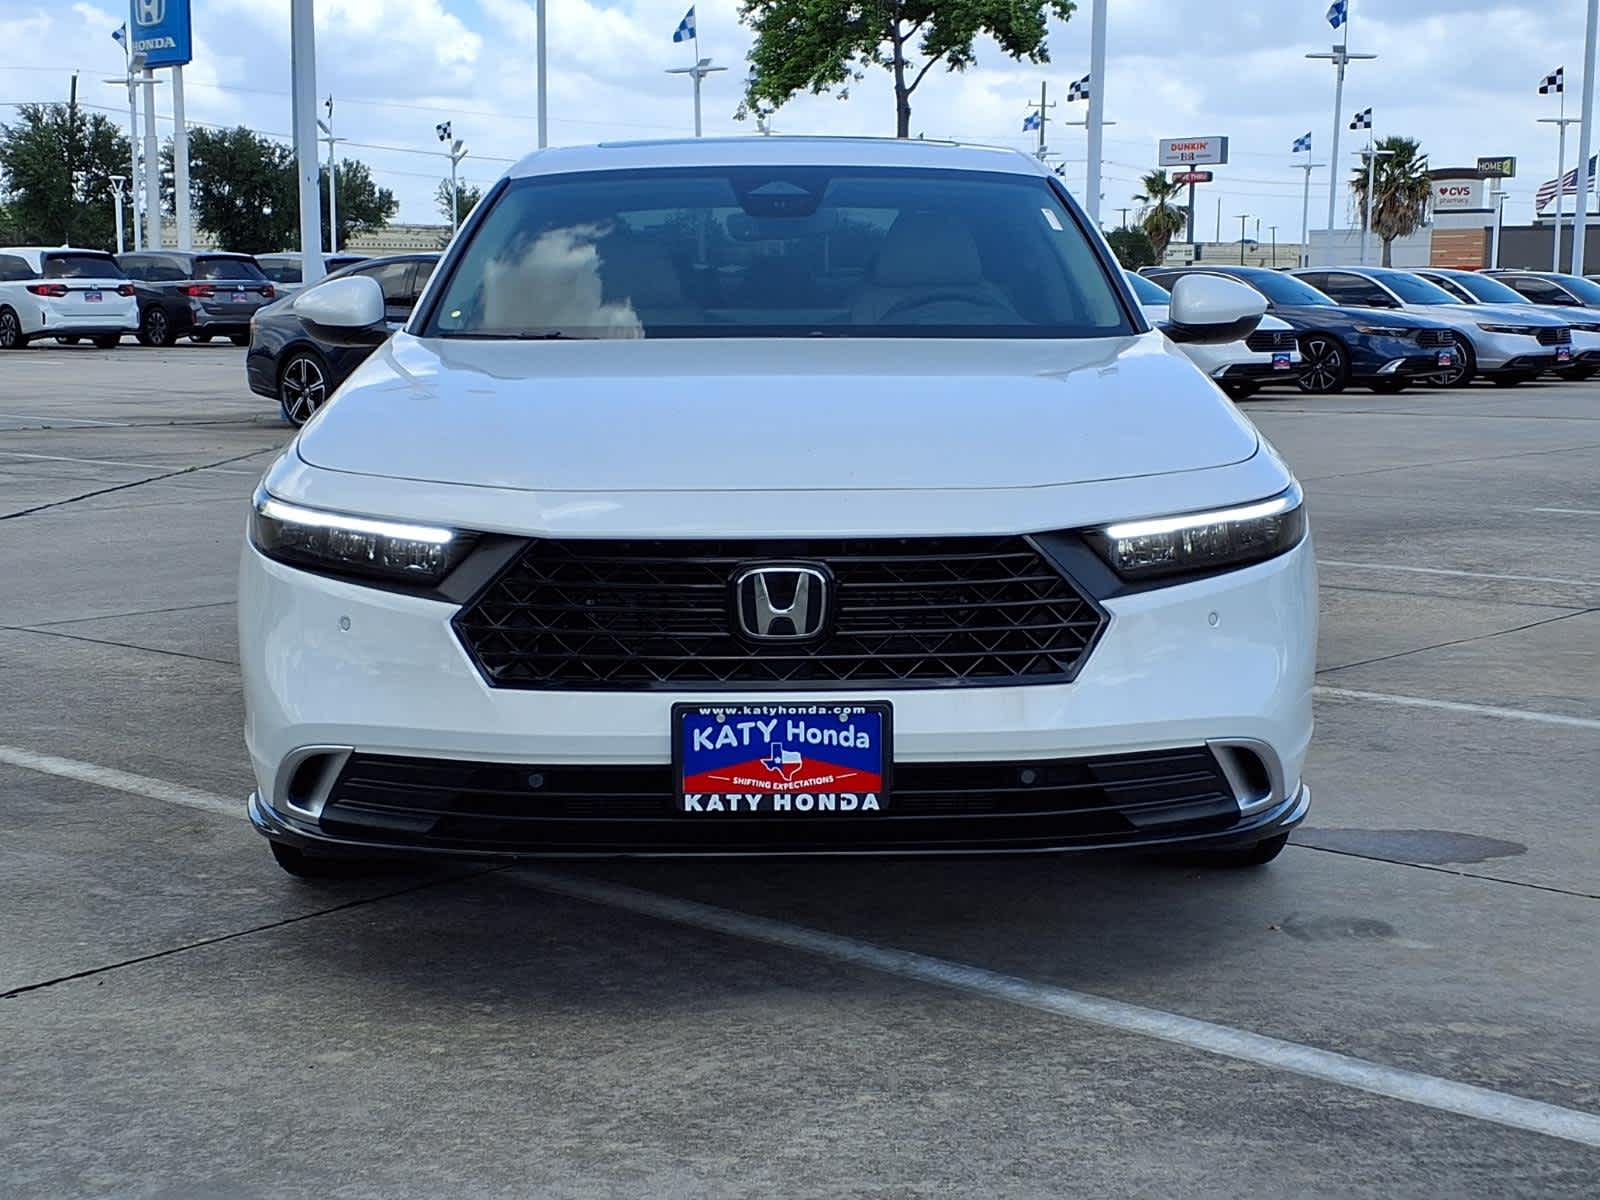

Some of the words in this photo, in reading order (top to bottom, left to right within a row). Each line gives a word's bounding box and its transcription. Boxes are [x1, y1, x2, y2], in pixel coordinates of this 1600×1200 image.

[1170, 142, 1208, 151] DUNKIN'
[1449, 186, 1470, 196] CVS
[699, 705, 866, 716] www.katyhonda.com
[693, 718, 778, 752] KATY
[786, 719, 870, 749] Honda
[732, 776, 771, 790] SHIFTING
[773, 775, 835, 790] EXPECTATIONS
[684, 793, 763, 812] KATY
[773, 793, 880, 811] HONDA
